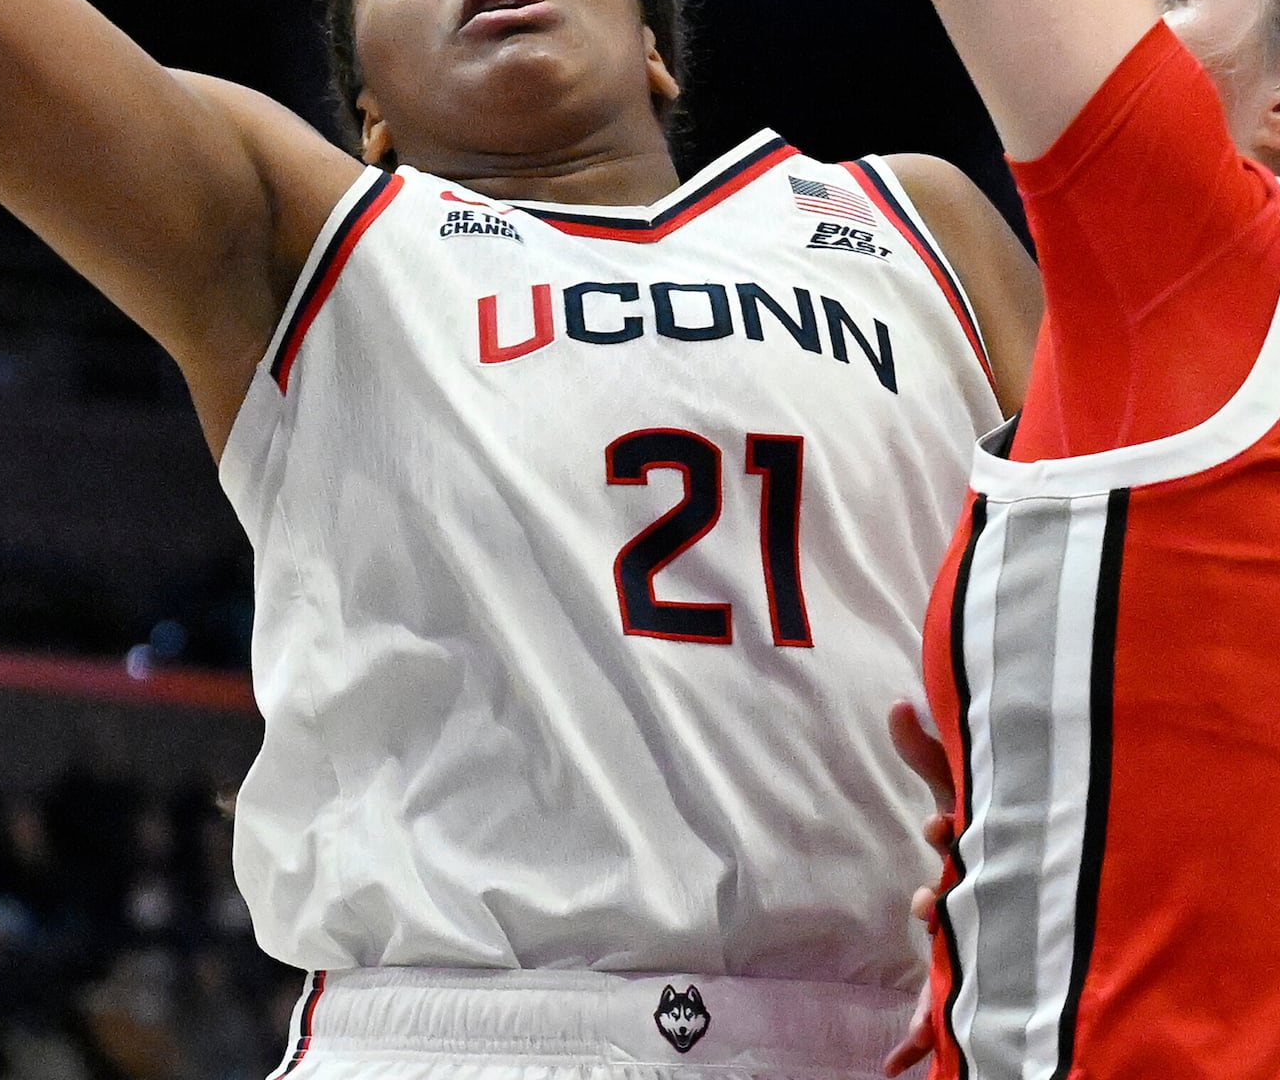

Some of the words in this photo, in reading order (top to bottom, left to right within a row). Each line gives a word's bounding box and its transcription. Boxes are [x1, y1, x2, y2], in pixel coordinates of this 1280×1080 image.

[447, 210, 475, 222] BE
[816, 222, 874, 242] BIG
[810, 233, 893, 257] EAST
[477, 281, 898, 395] UCONN
[605, 427, 814, 648] 21
